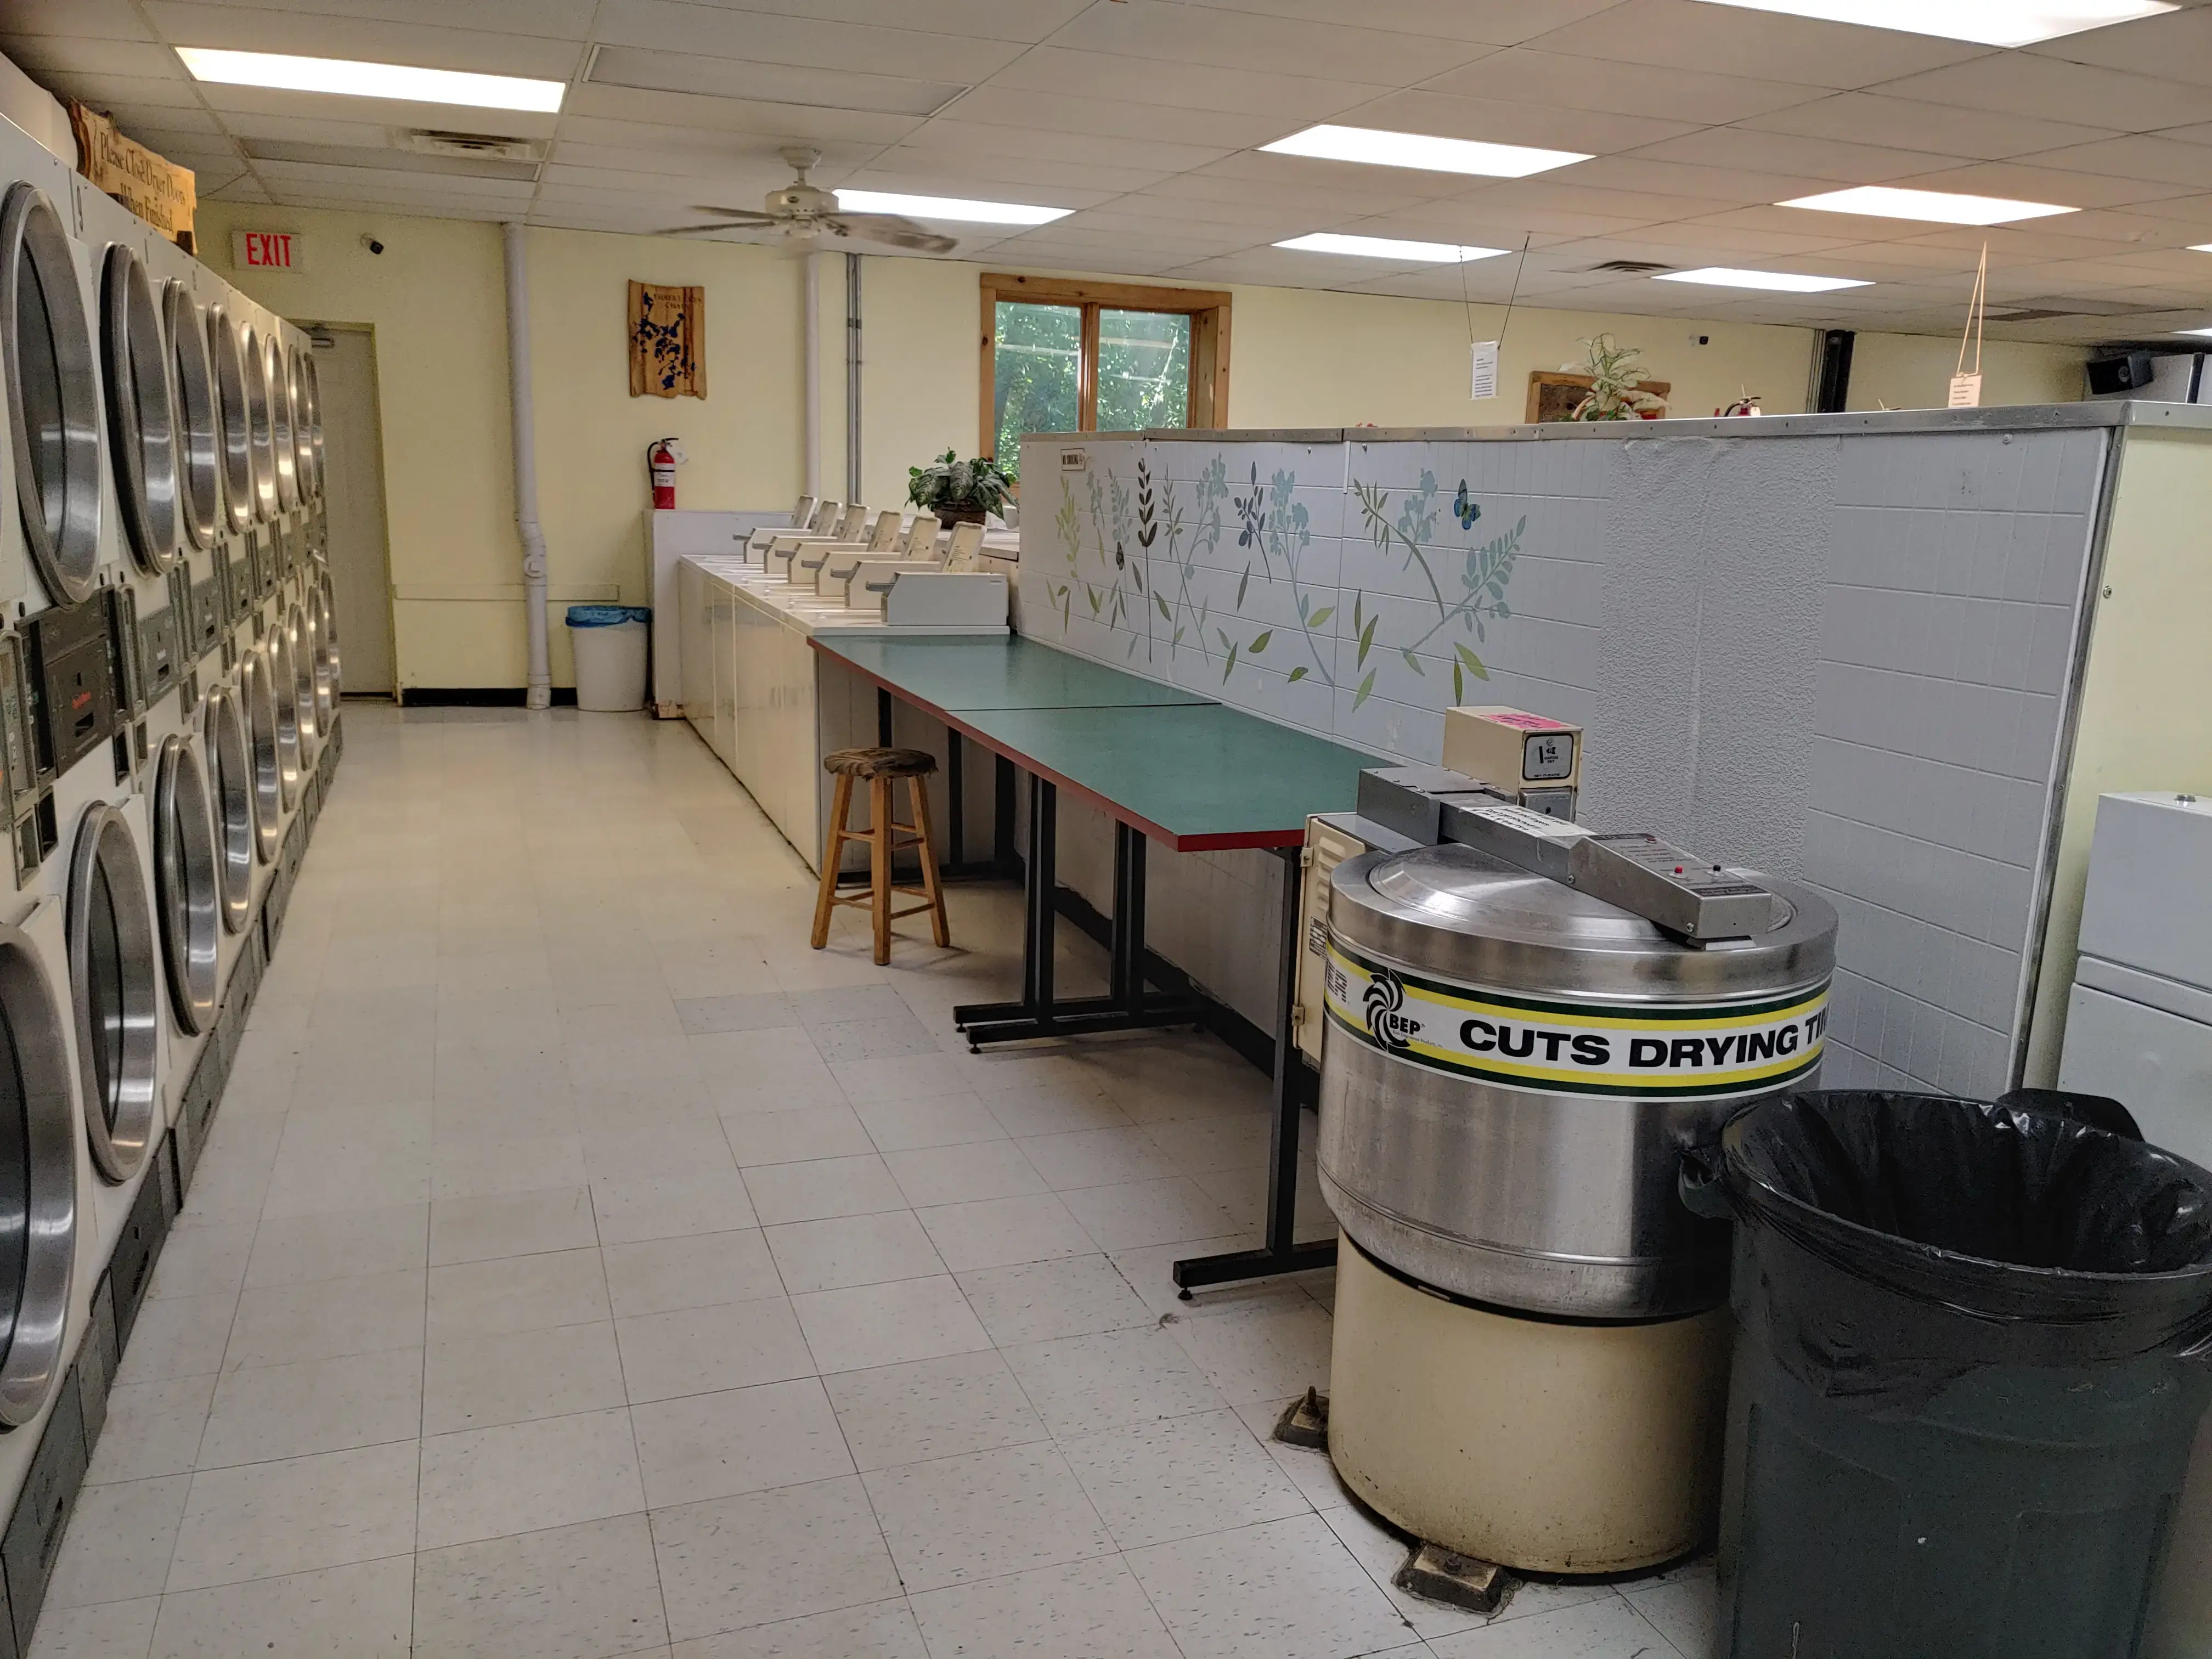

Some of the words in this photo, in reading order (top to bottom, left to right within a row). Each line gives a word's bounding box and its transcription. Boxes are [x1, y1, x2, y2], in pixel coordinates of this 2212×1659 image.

[101, 132, 125, 170] Please
[146, 160, 165, 196] Dryer
[166, 174, 186, 206] Doors
[144, 195, 174, 233] Finished
[246, 233, 292, 267] EXIT
[1389, 1013, 1421, 1035] BEP
[1459, 1018, 1611, 1066] CUTS
[1628, 1024, 1798, 1068] DRYING
